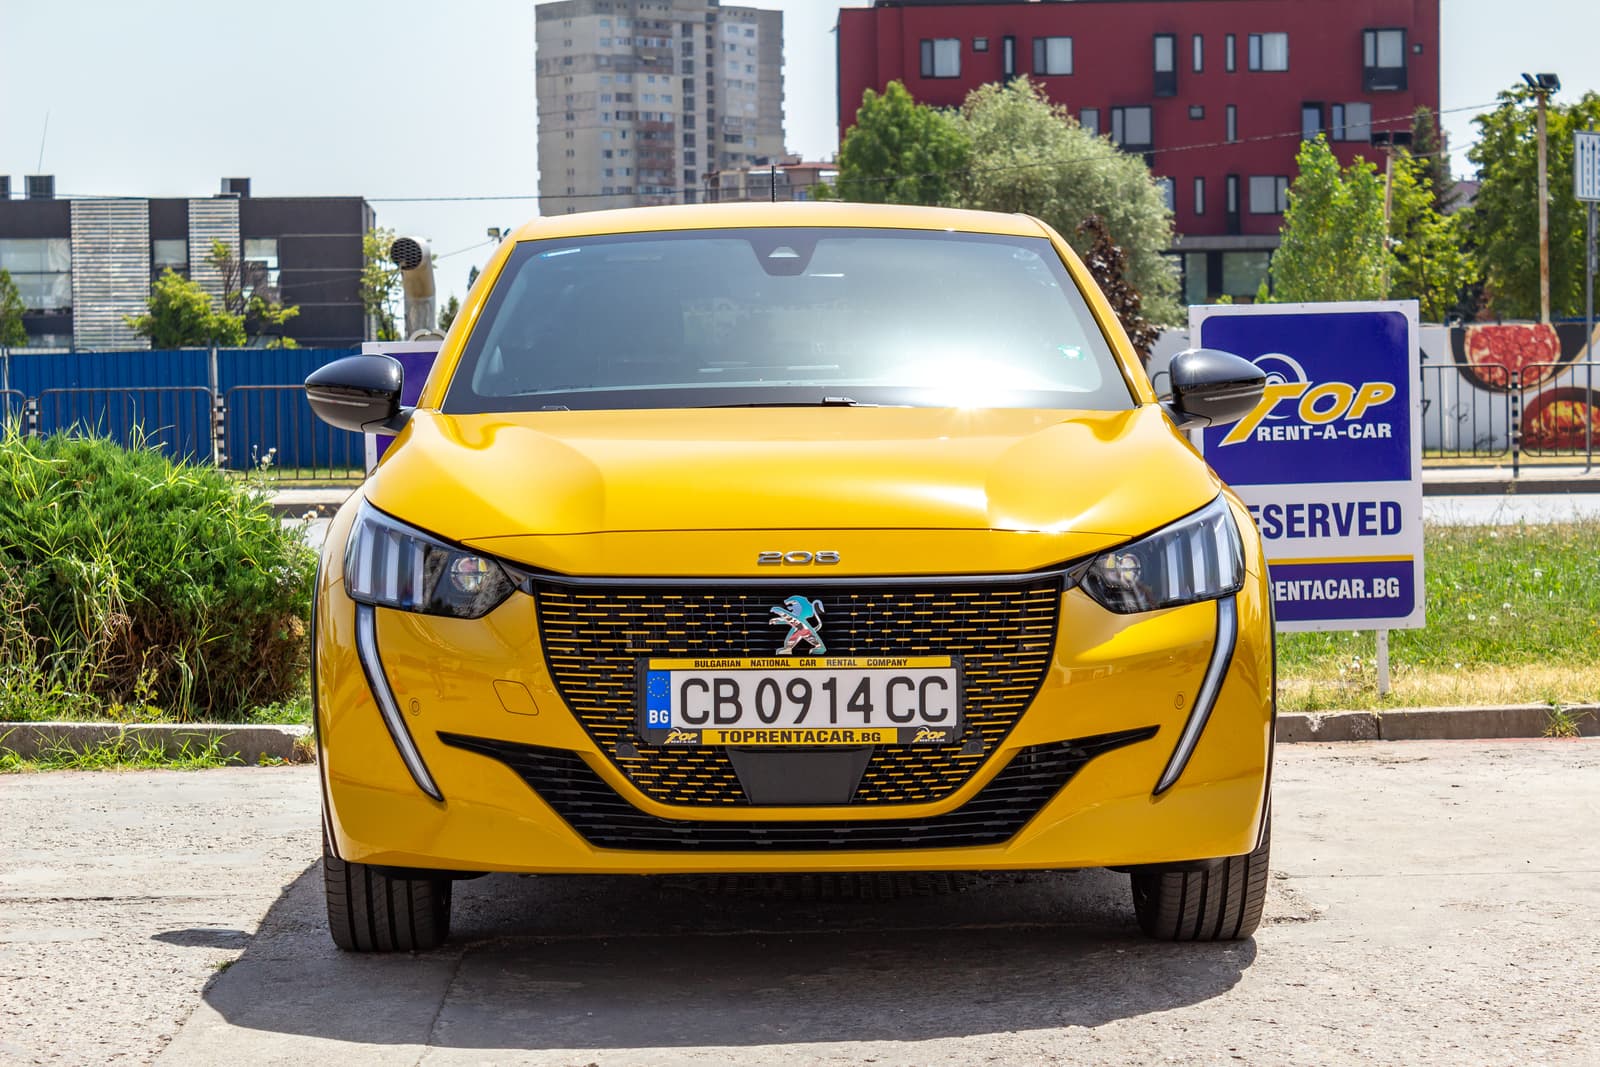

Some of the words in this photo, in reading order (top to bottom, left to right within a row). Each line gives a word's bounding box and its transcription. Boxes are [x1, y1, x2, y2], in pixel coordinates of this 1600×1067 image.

[1218, 381, 1396, 447] TOP
[1257, 423, 1392, 442] RENT-A-CAR
[757, 550, 840, 564] 208
[1271, 577, 1400, 601] ENTACAR.BG
[694, 659, 741, 668] BULGARIAN
[750, 658, 790, 667] NATIONAL
[799, 658, 817, 667] CAR
[826, 658, 857, 667] RENTAL
[866, 658, 908, 667] COMPANY
[680, 677, 743, 725] CB
[755, 676, 874, 724] 0914
[886, 676, 949, 723] CC
[649, 709, 669, 724] BG
[664, 731, 698, 744] TOP
[718, 730, 881, 743] TOPRENTACAR.BG
